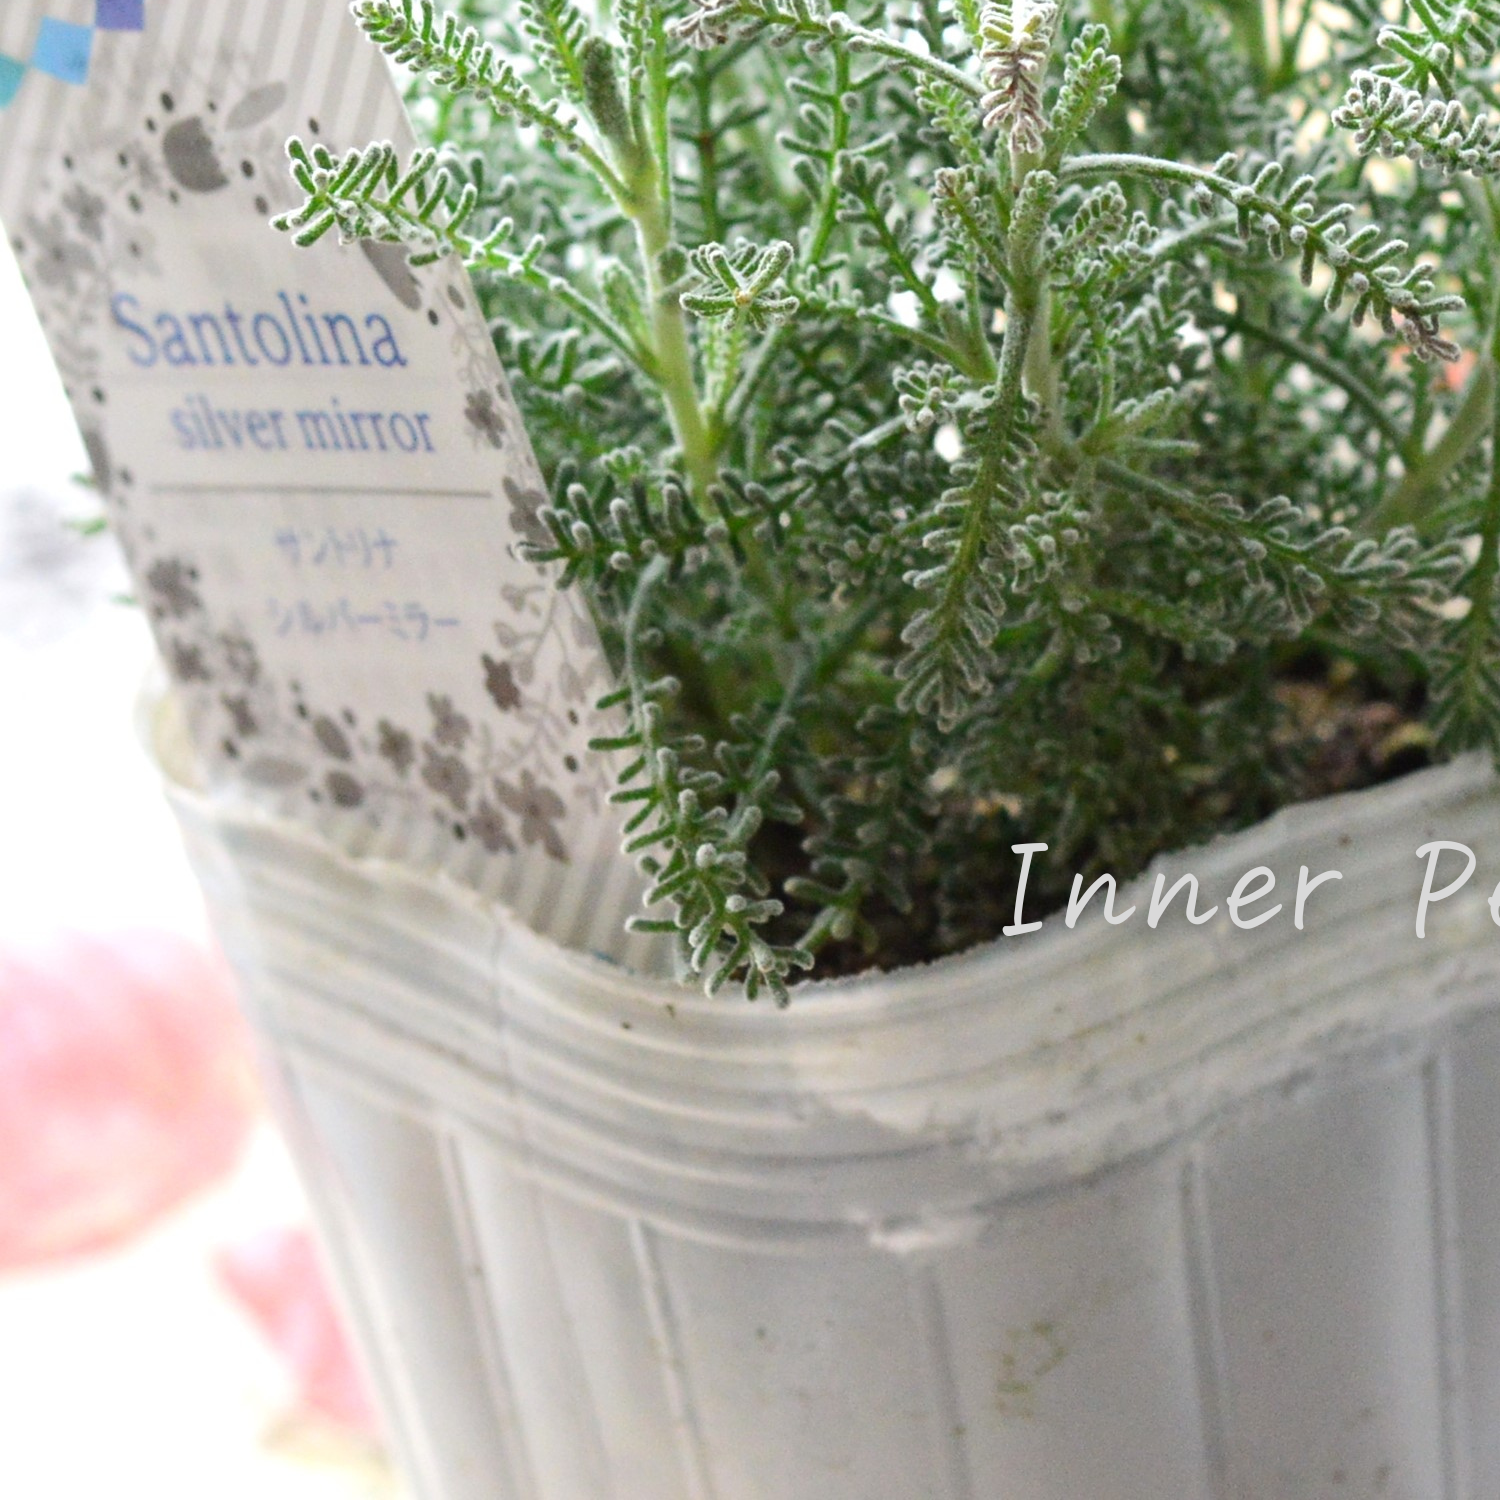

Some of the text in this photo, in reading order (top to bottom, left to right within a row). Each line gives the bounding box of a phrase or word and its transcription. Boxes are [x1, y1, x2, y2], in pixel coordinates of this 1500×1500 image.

[110, 290, 408, 368] Santolina
[170, 394, 436, 453] silver mirror
